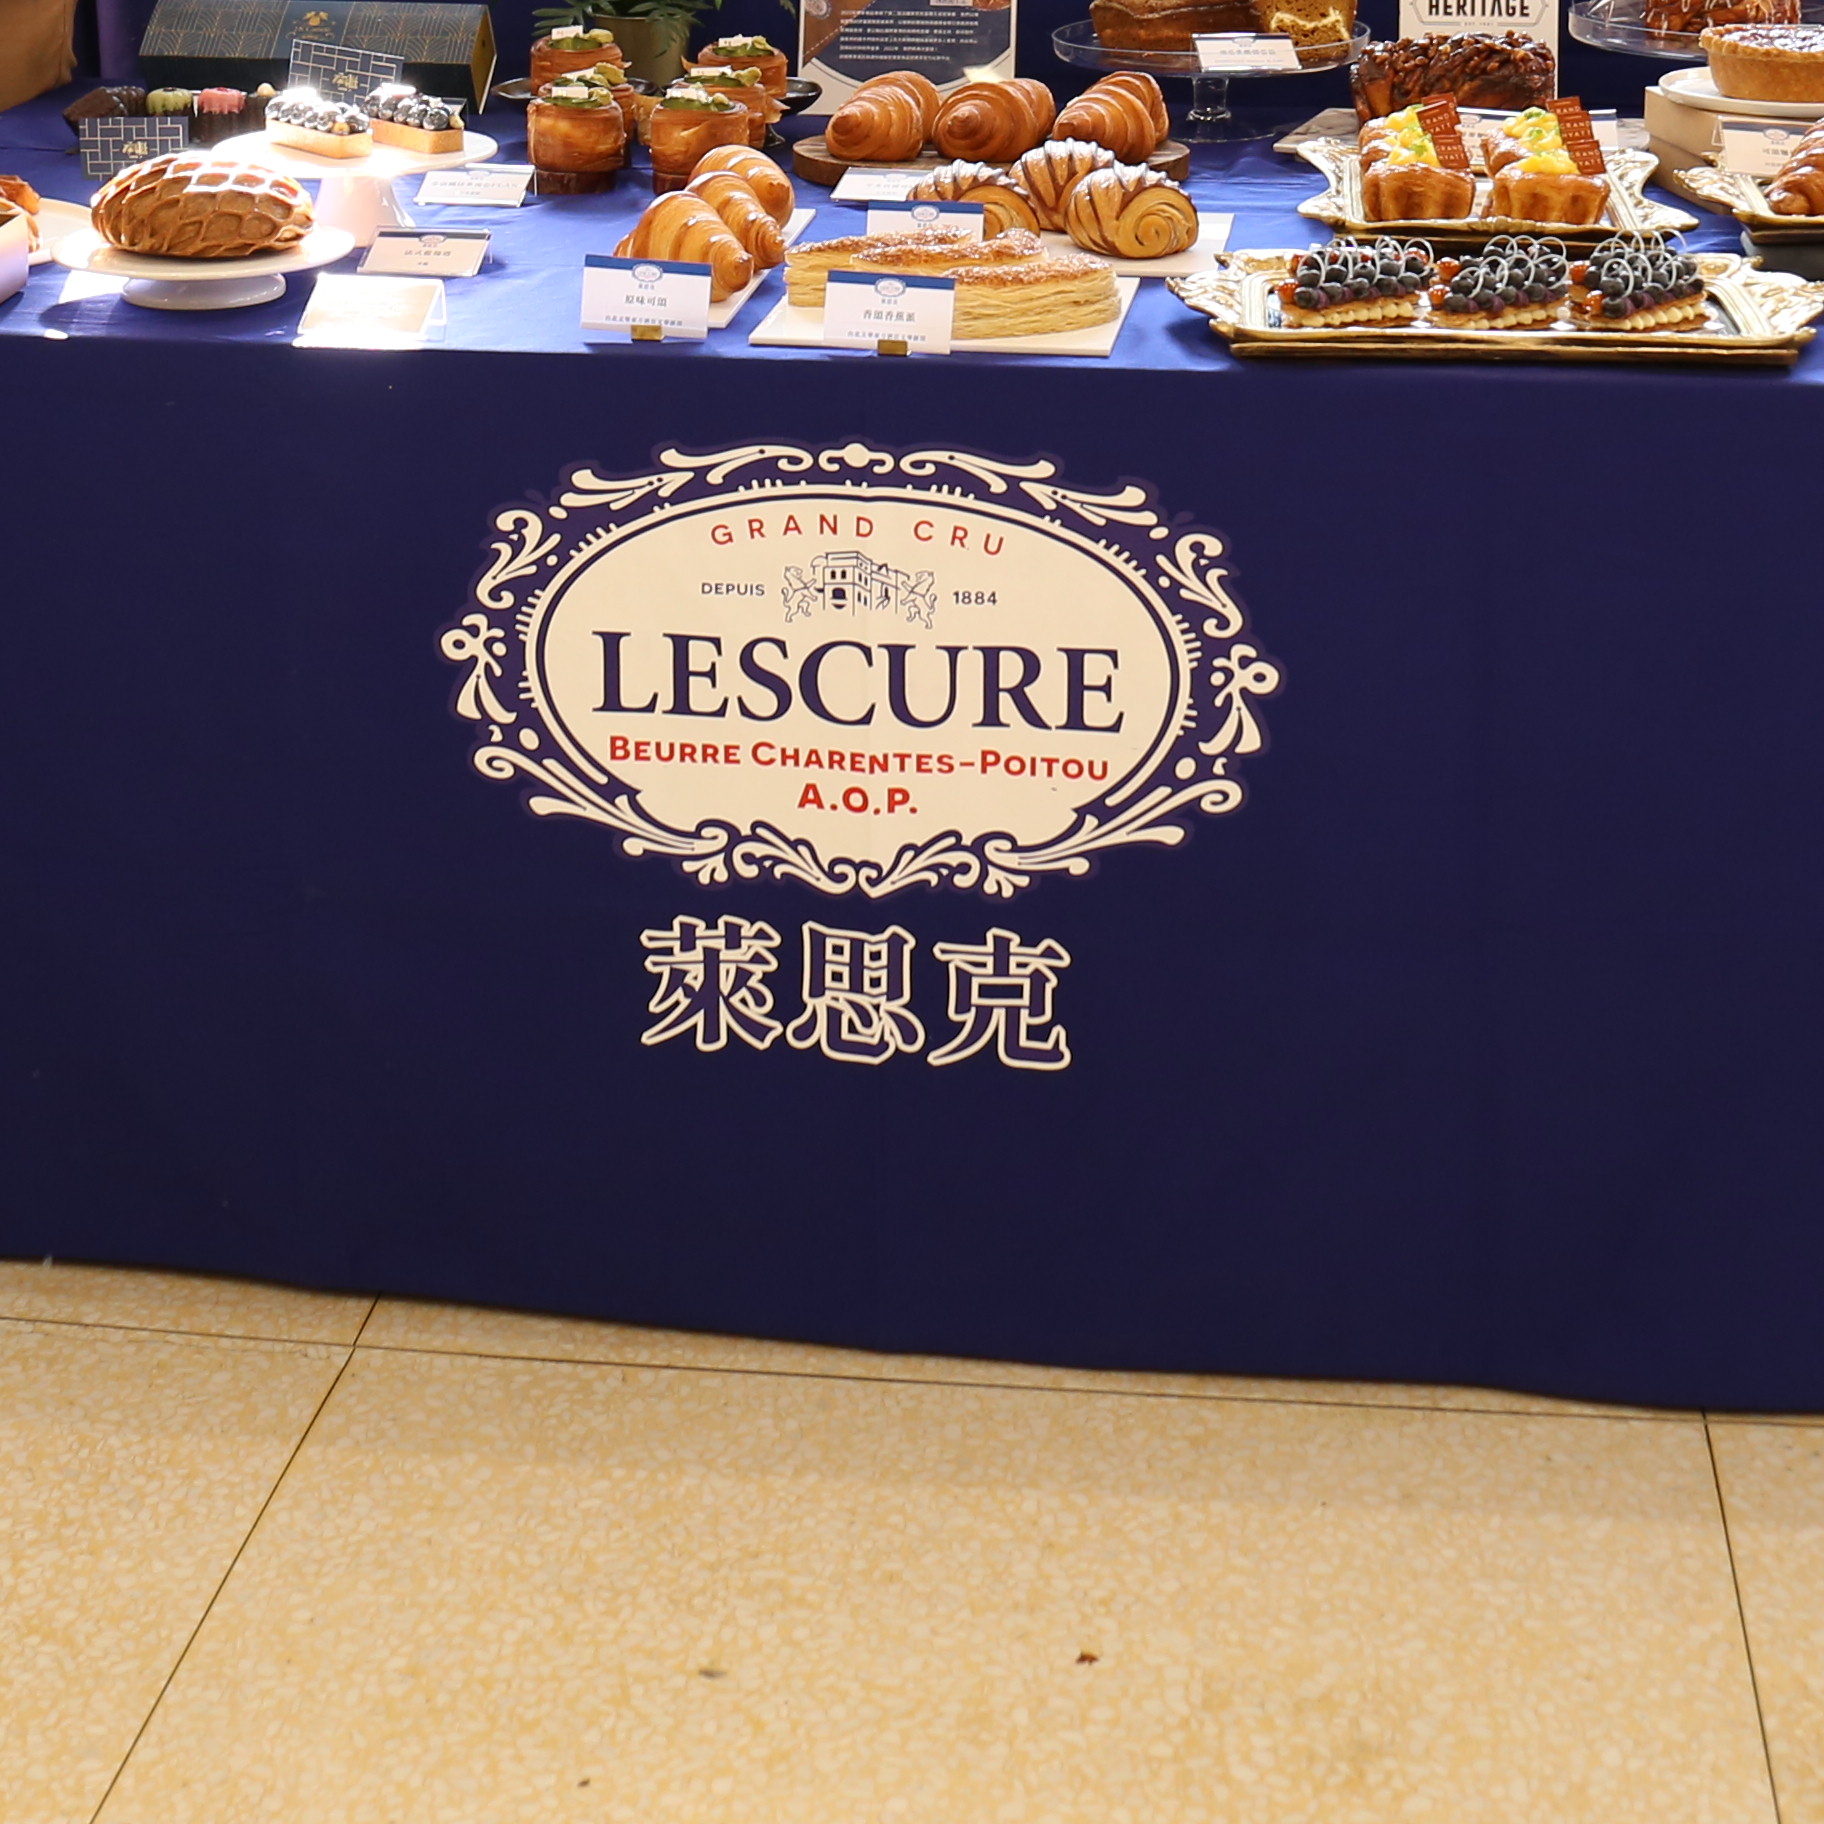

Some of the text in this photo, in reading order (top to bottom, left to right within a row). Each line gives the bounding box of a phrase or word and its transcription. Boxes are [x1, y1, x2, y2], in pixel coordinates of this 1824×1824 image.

[624, 295, 668, 307] 原味可頌
[710, 514, 1006, 557] GRAND CRU
[701, 581, 999, 607] DEPUIS 1884
[591, 630, 1125, 735] LESCURE
[609, 734, 1110, 782] BEURRE CHARENTES-POITOU
[796, 782, 919, 815] A.O.P.
[639, 914, 1072, 1071] 萊思克
